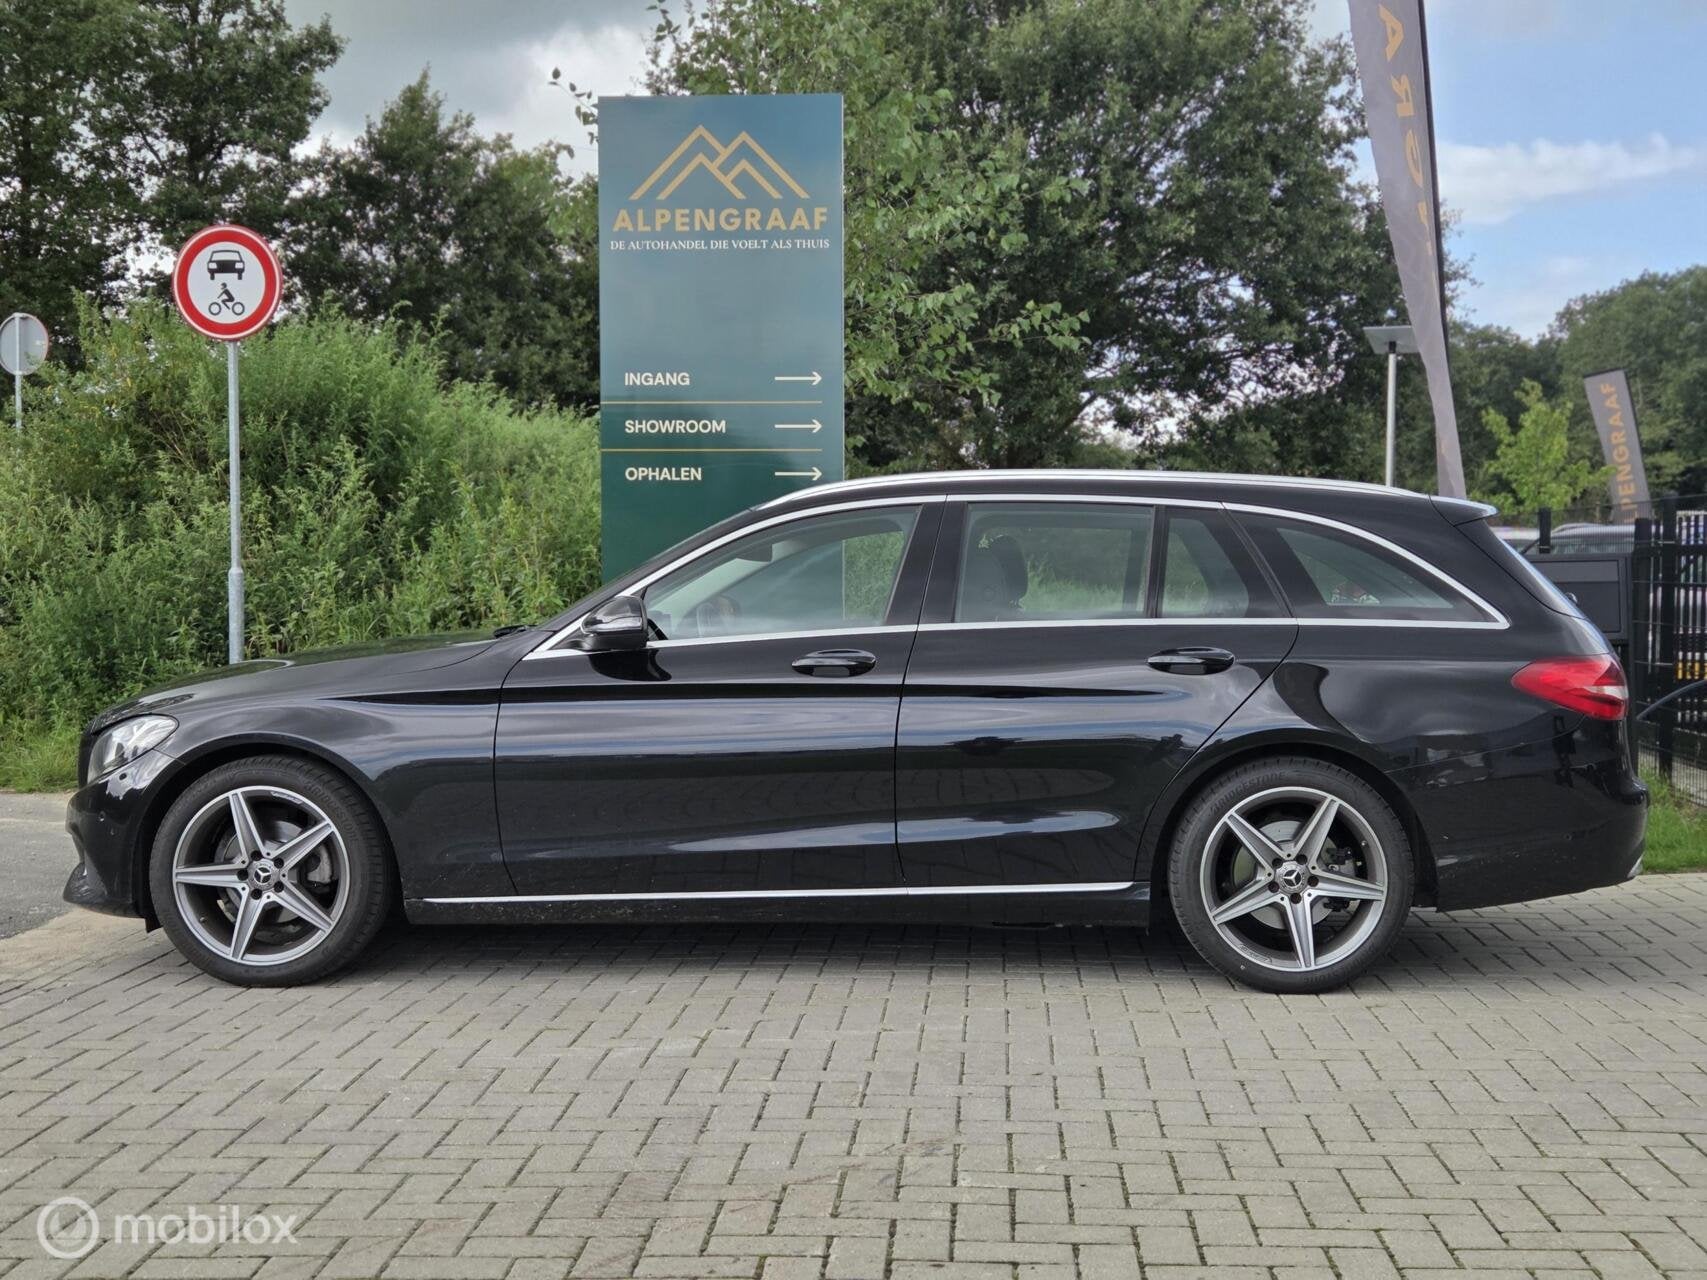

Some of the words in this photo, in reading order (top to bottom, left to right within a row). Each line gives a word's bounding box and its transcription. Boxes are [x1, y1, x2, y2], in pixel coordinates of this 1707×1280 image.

[612, 207, 828, 232] ALPENGRAAF
[610, 240, 625, 250] DE
[627, 240, 708, 250] AUTOHANDEL
[710, 239, 729, 250] DIE
[731, 239, 769, 250] VOELT
[771, 239, 792, 249] ALS
[794, 238, 830, 249] THUIS
[624, 372, 690, 386] INGANG
[624, 419, 726, 434] SHOWROOM
[625, 467, 702, 481] OPHALEN
